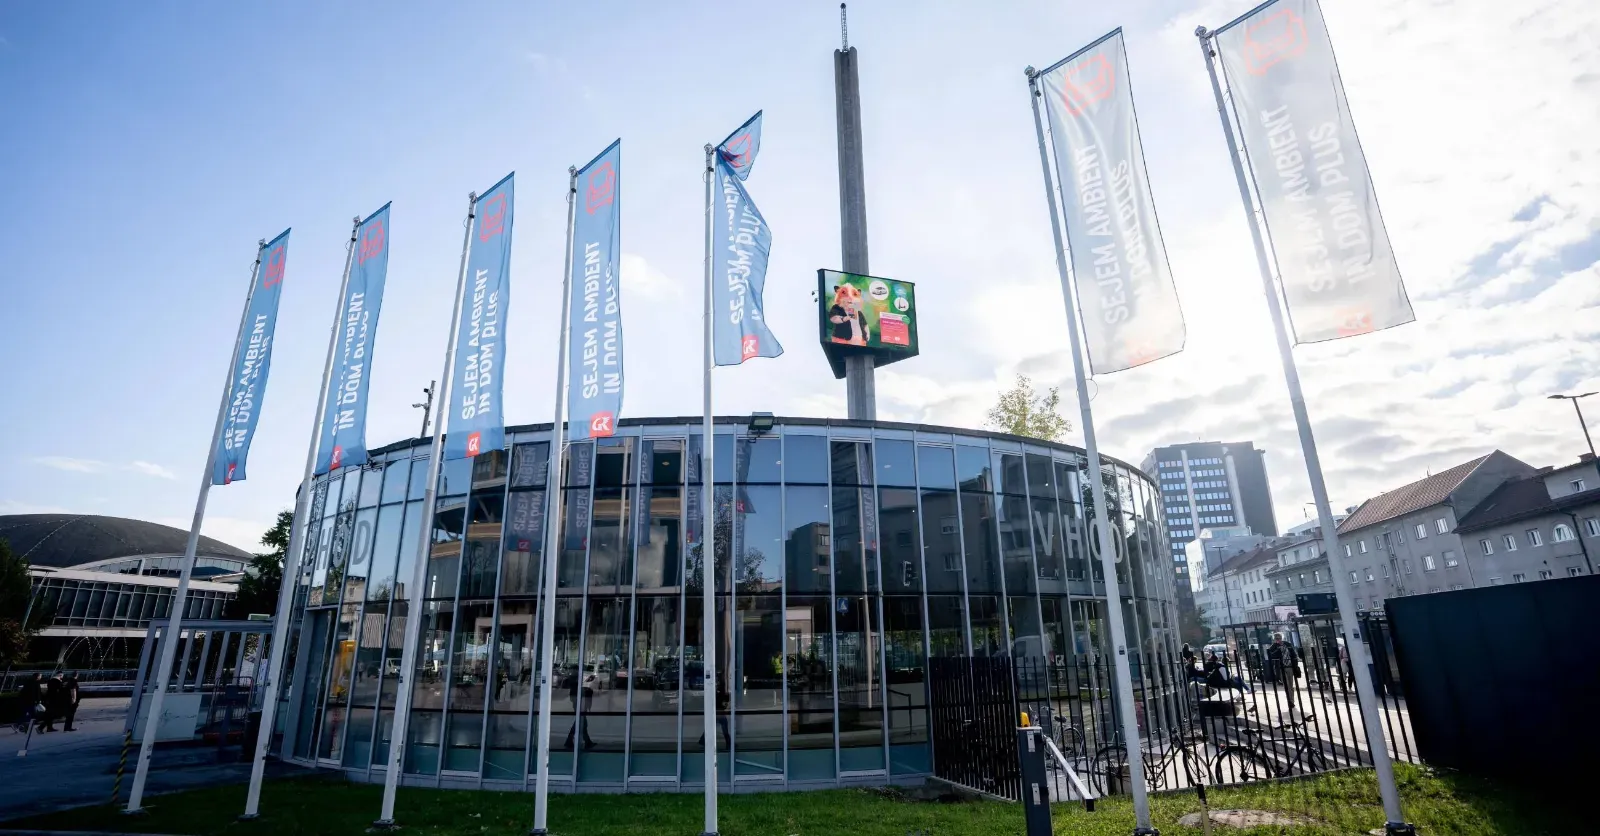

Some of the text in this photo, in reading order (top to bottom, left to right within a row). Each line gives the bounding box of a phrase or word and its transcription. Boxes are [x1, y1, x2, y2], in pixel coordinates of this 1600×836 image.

[1261, 104, 1312, 203] AMBIENT
[1308, 121, 1349, 188] PLUS
[1110, 158, 1141, 222] PLUS
[1327, 190, 1370, 248] DOM
[1074, 143, 1129, 326] SEJEM AMBIENT
[241, 313, 268, 386] AMBIENT
[462, 268, 489, 420] SEJEM AMBIENT
[582, 241, 600, 400] SEJEM AMBIENT
[342, 363, 364, 405] DOM
[479, 342, 495, 390] DOM
[603, 372, 620, 394] IN
[338, 408, 355, 430] IN
[478, 392, 492, 416] IN
[234, 428, 248, 449] IN
